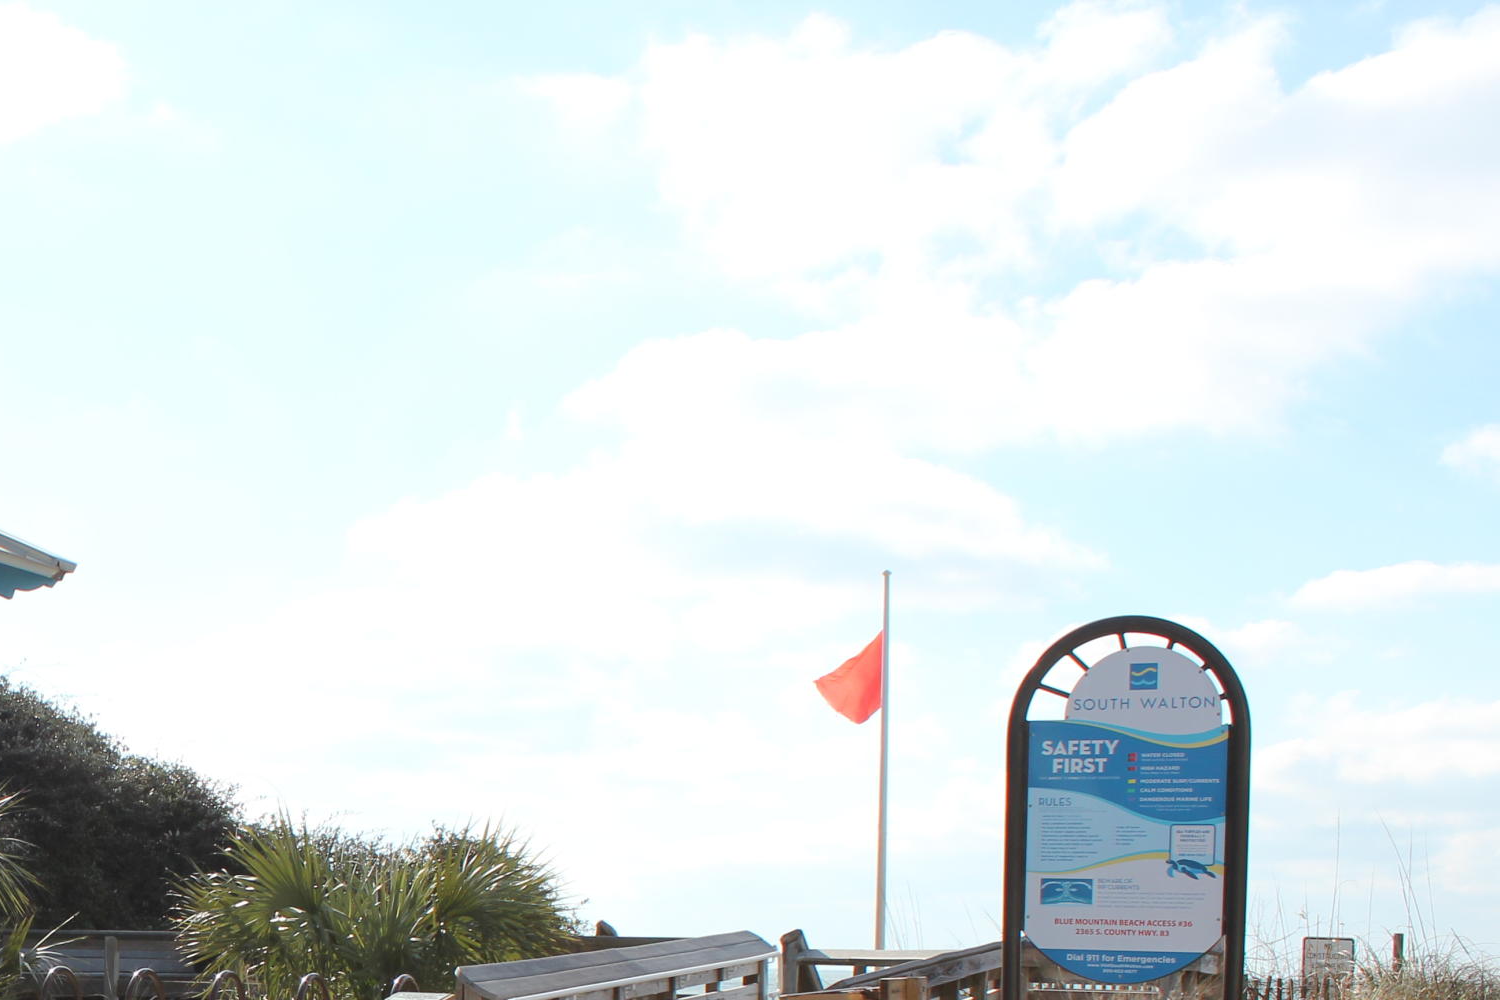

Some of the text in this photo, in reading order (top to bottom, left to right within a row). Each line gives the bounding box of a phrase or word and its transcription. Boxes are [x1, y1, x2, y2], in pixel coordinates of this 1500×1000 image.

[1073, 696, 1216, 711] SOUTH WALTON
[1041, 739, 1119, 756] SAFETY
[1052, 757, 1108, 774] FIRST
[1038, 797, 1072, 807] RULES
[1075, 918, 1118, 926] MOUNTAIN
[1119, 919, 1145, 927] BEACH
[1146, 919, 1177, 927] ACCESS
[1104, 928, 1136, 936] COUNTY
[1138, 929, 1159, 937] HWY.
[1066, 953, 1176, 964] Dial 911 for Emergencies
